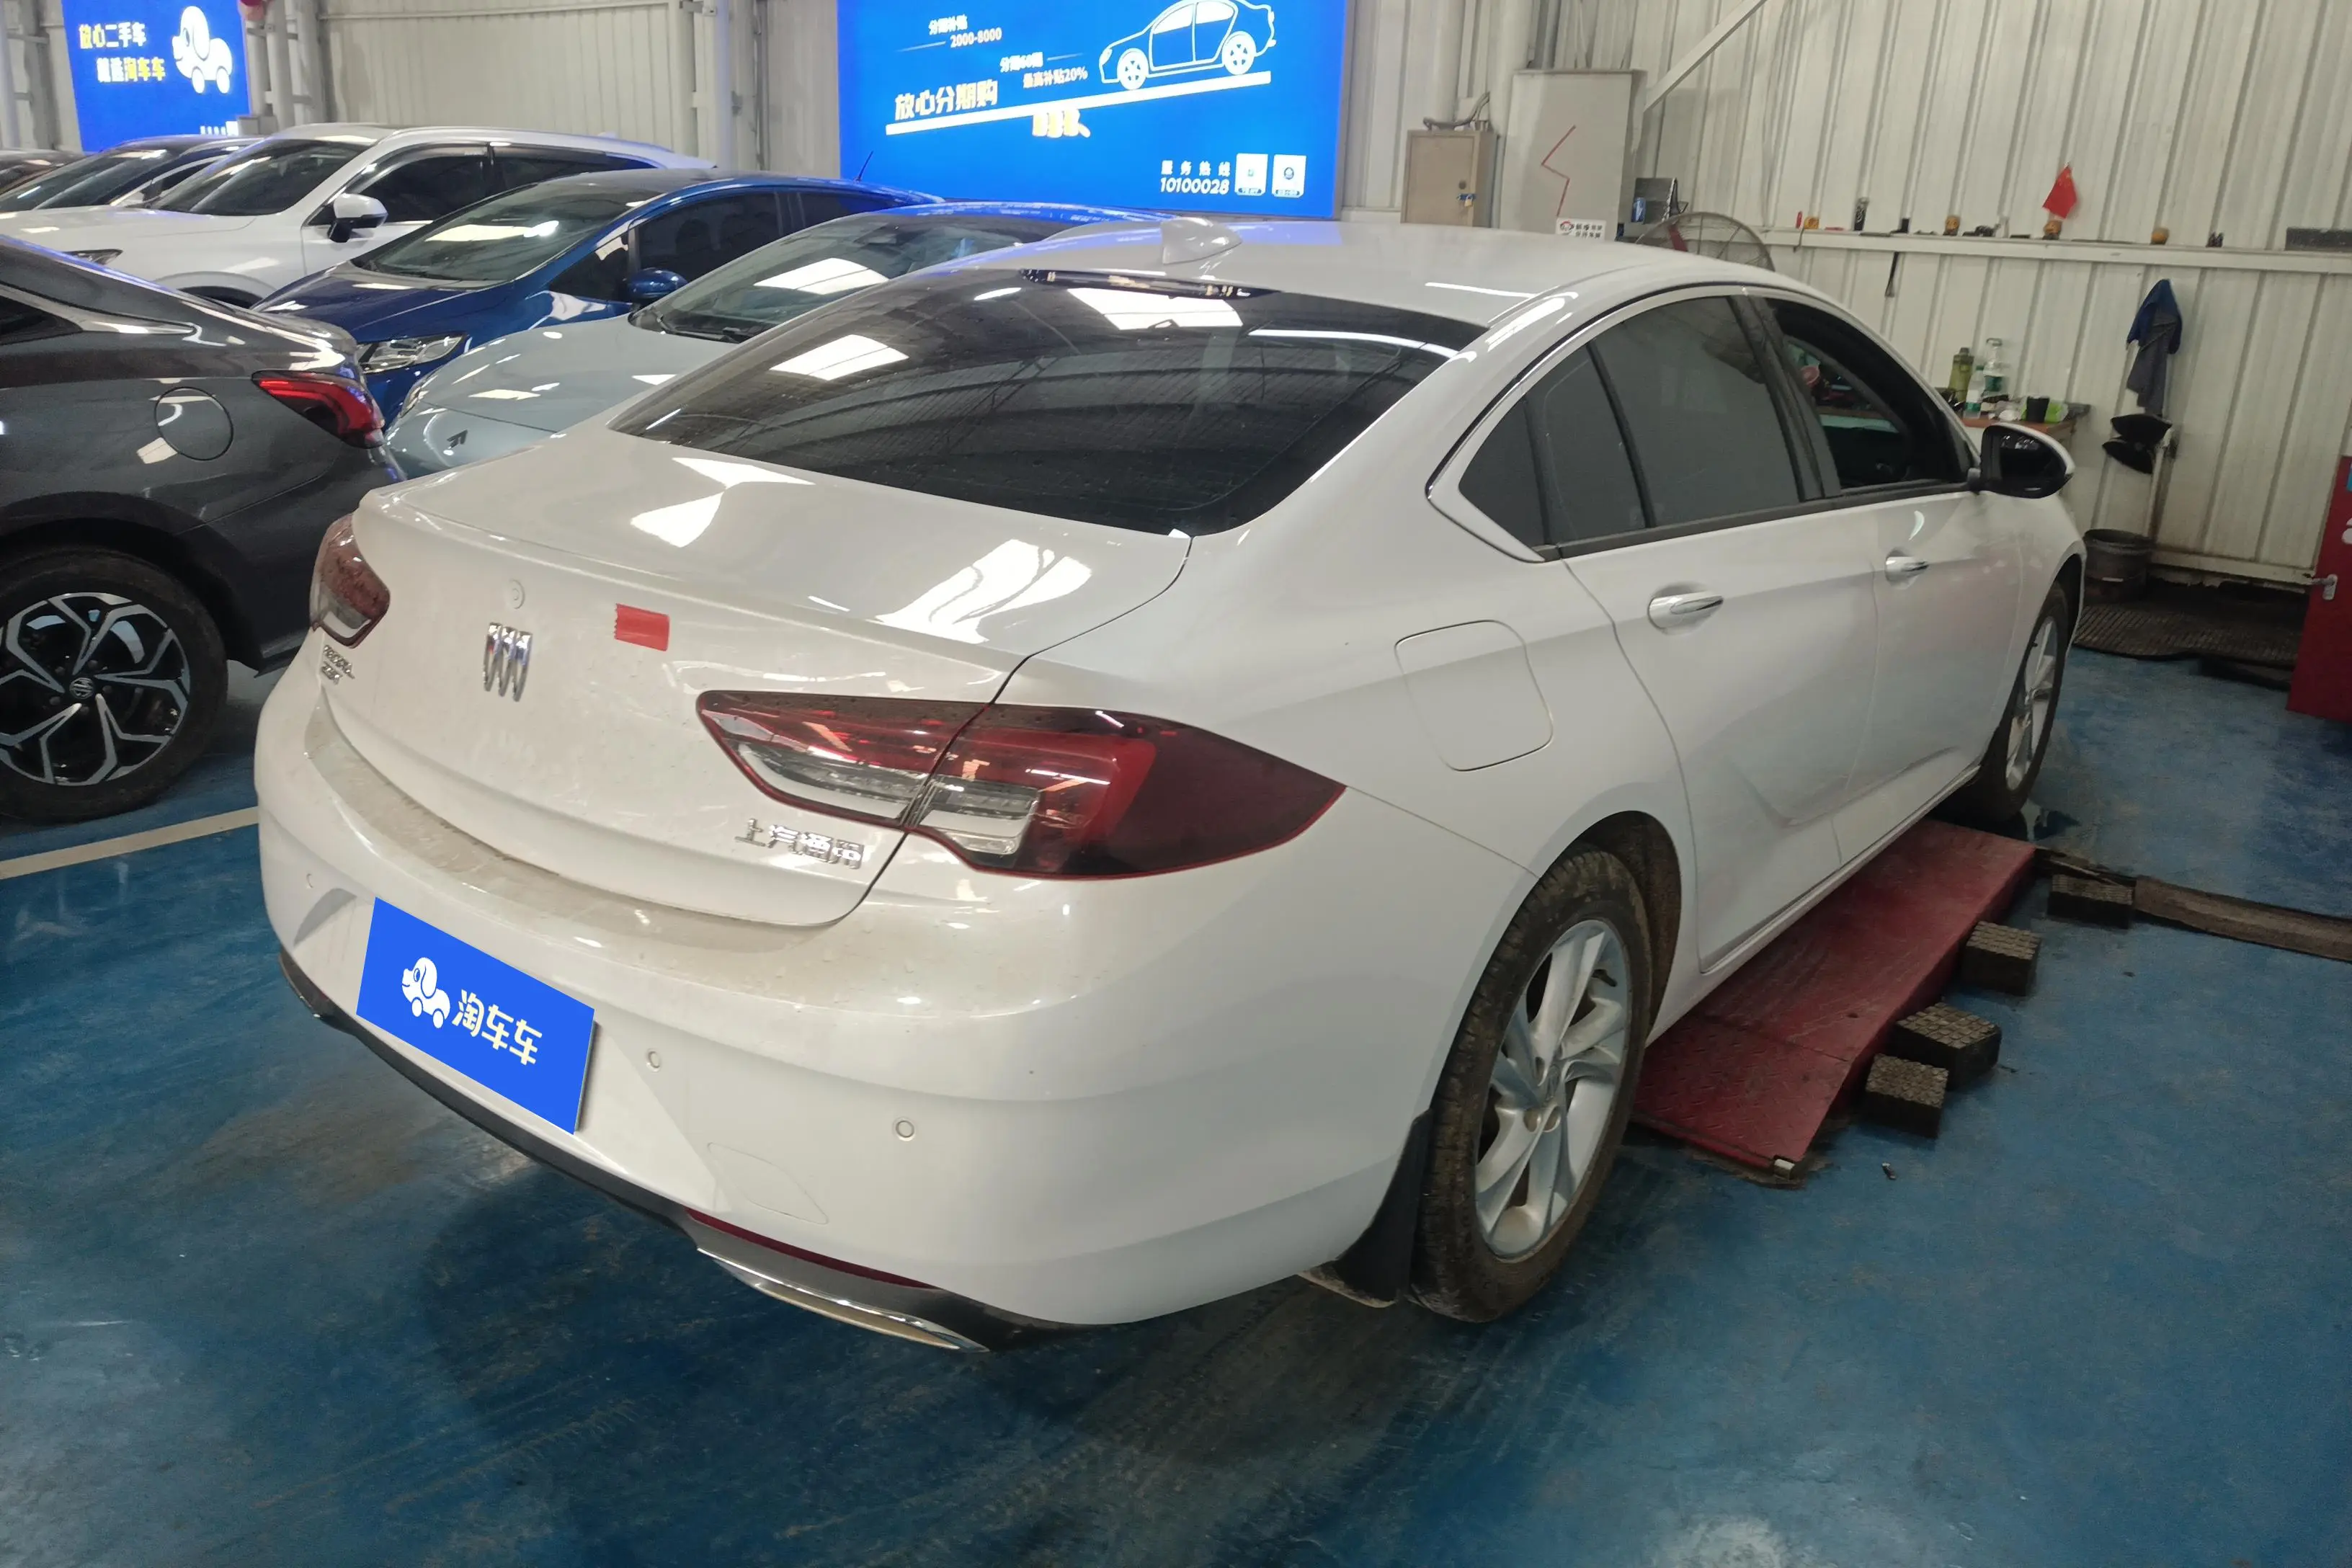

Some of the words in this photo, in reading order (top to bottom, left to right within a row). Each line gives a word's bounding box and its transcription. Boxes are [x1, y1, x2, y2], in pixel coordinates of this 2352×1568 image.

[79, 22, 147, 49] 放心二手车
[950, 27, 1002, 48] 2000-8000
[895, 79, 998, 120] 放心分期购
[1160, 177, 1229, 195] 10100028
[734, 818, 865, 869] 上汽通用
